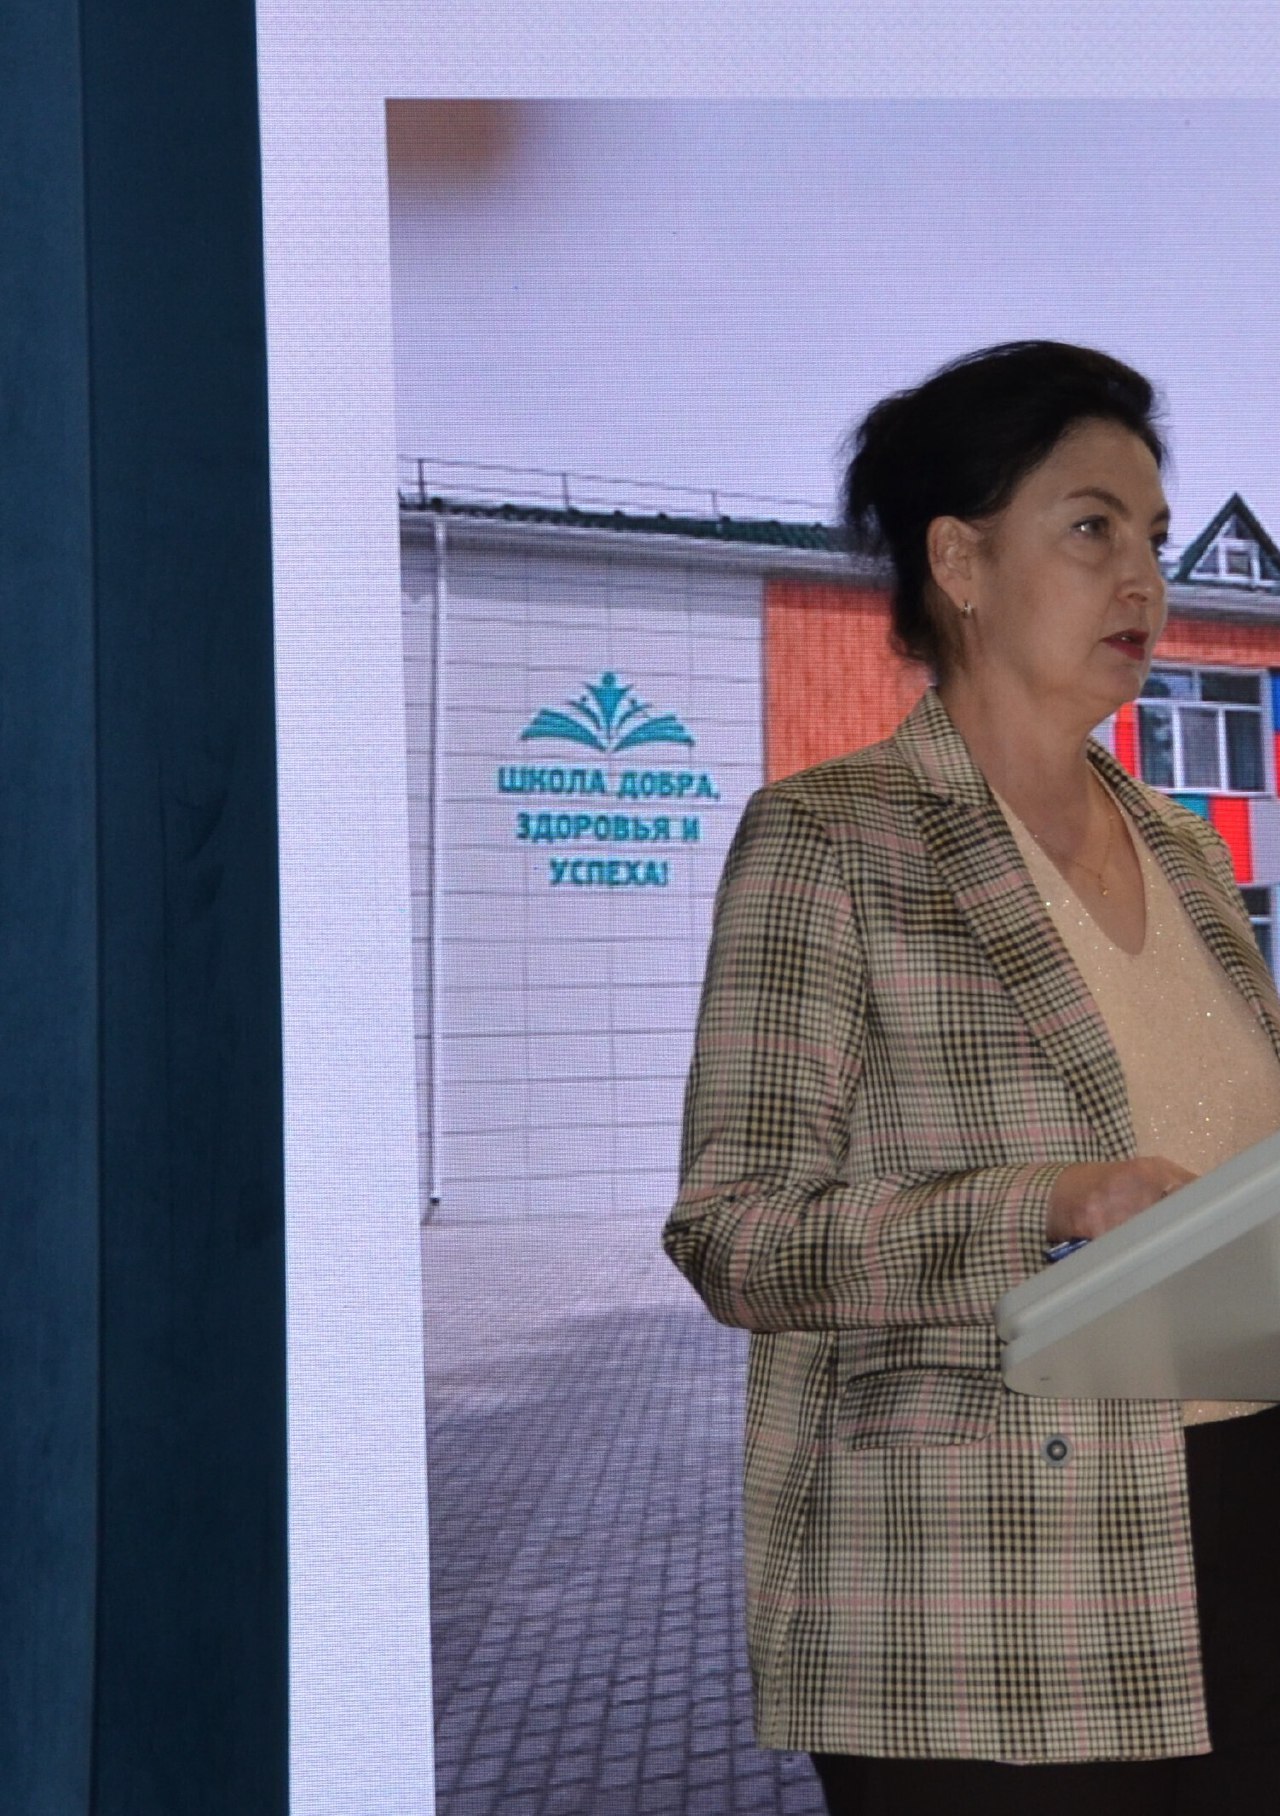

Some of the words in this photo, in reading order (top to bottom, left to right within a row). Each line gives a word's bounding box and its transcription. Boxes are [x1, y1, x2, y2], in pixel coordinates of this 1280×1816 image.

[498, 766, 605, 793] ШКОЛА
[516, 812, 669, 842] ЗДОРОВЬЯ
[682, 816, 700, 841] И
[550, 859, 668, 886] УСПЕХА!
